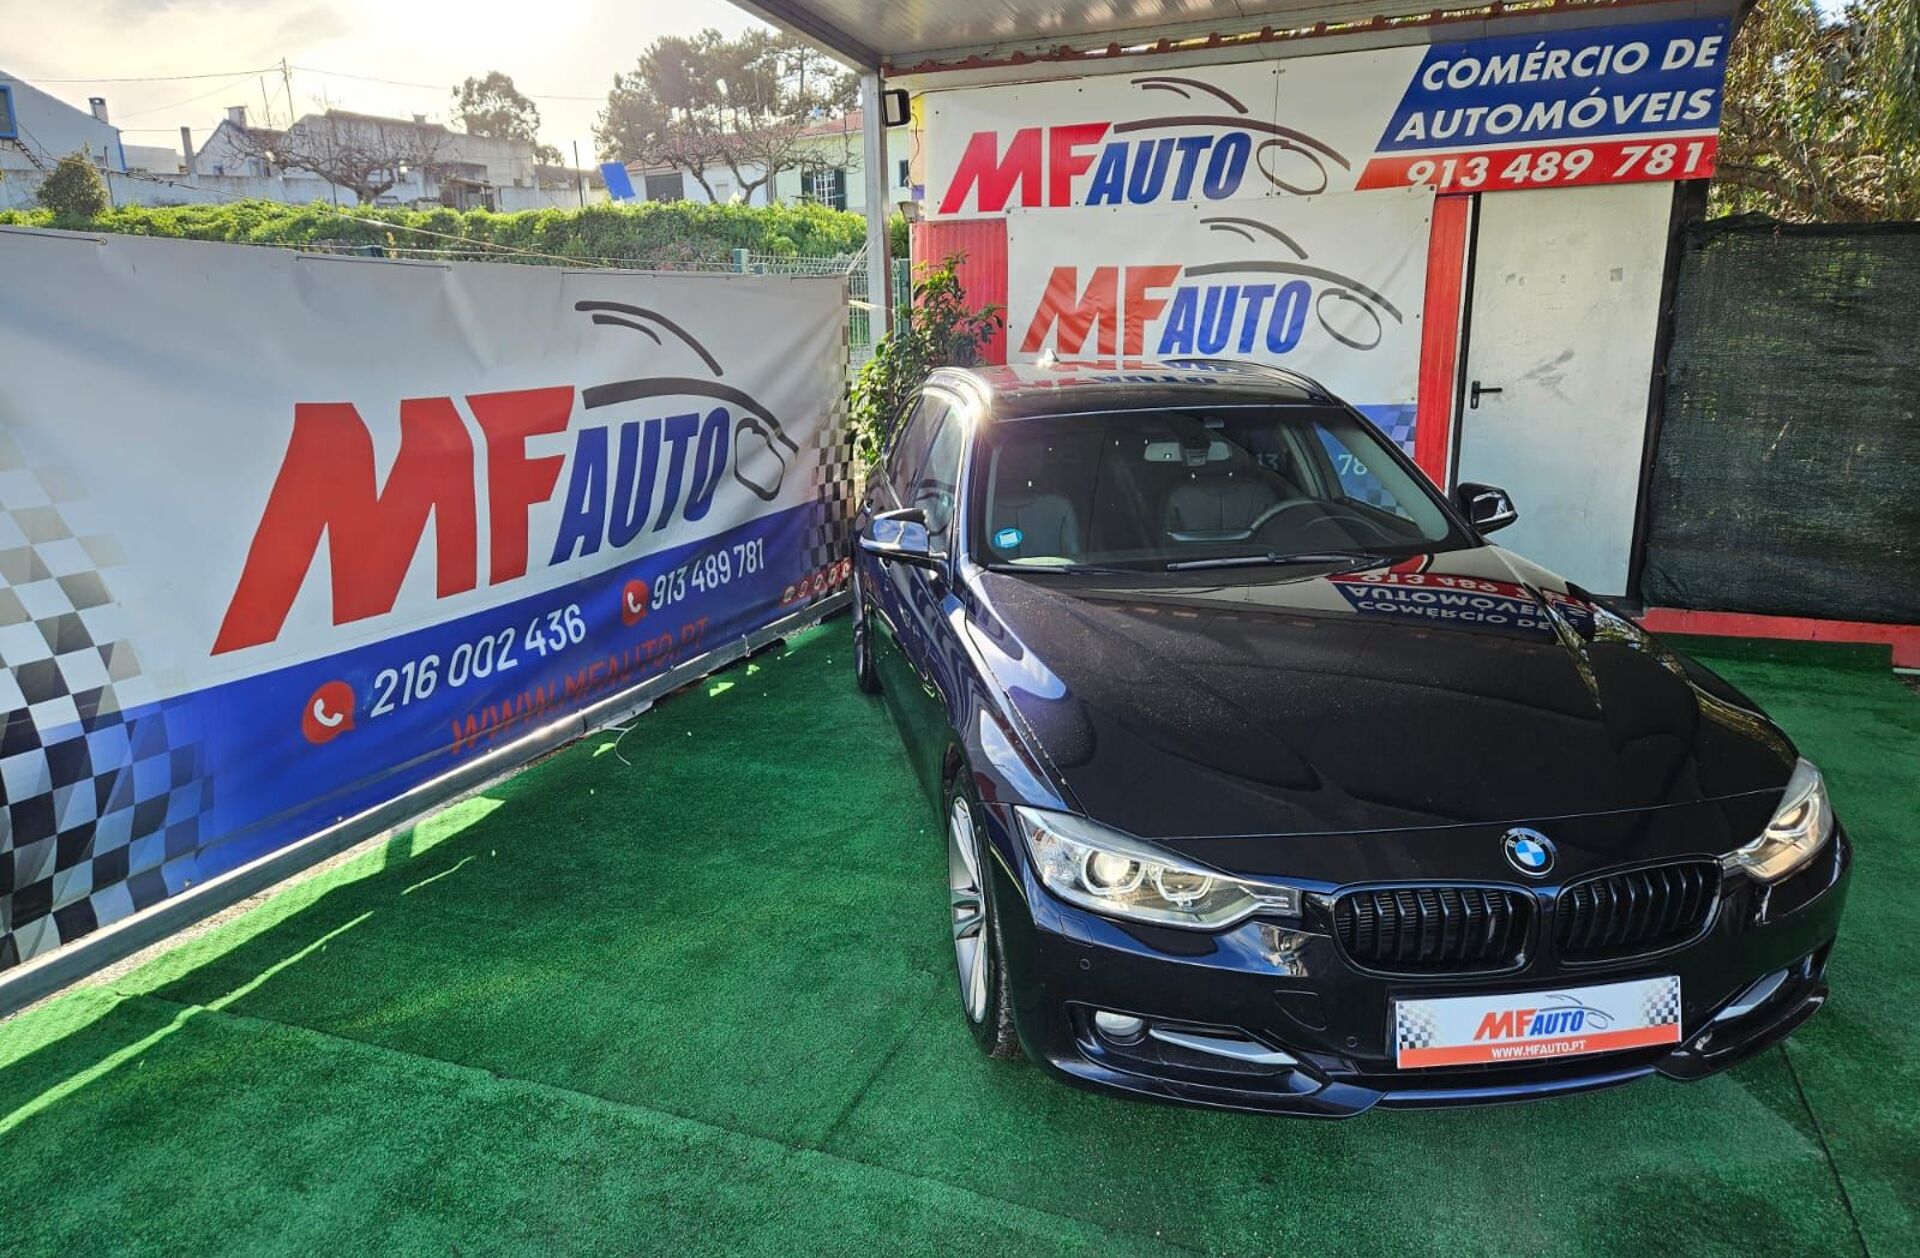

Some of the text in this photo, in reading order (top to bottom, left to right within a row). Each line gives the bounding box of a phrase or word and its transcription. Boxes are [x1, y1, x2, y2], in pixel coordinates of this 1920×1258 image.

[1422, 35, 1722, 91] COMÉRCIO DE
[1394, 87, 1716, 142] AUTOMÓVEIS
[1406, 142, 1704, 188] 913 489 781
[651, 538, 764, 610] 913 489 781
[370, 603, 587, 718] 216 002 436
[1491, 1040, 1586, 1058] WWW.MFAUTO.PT
